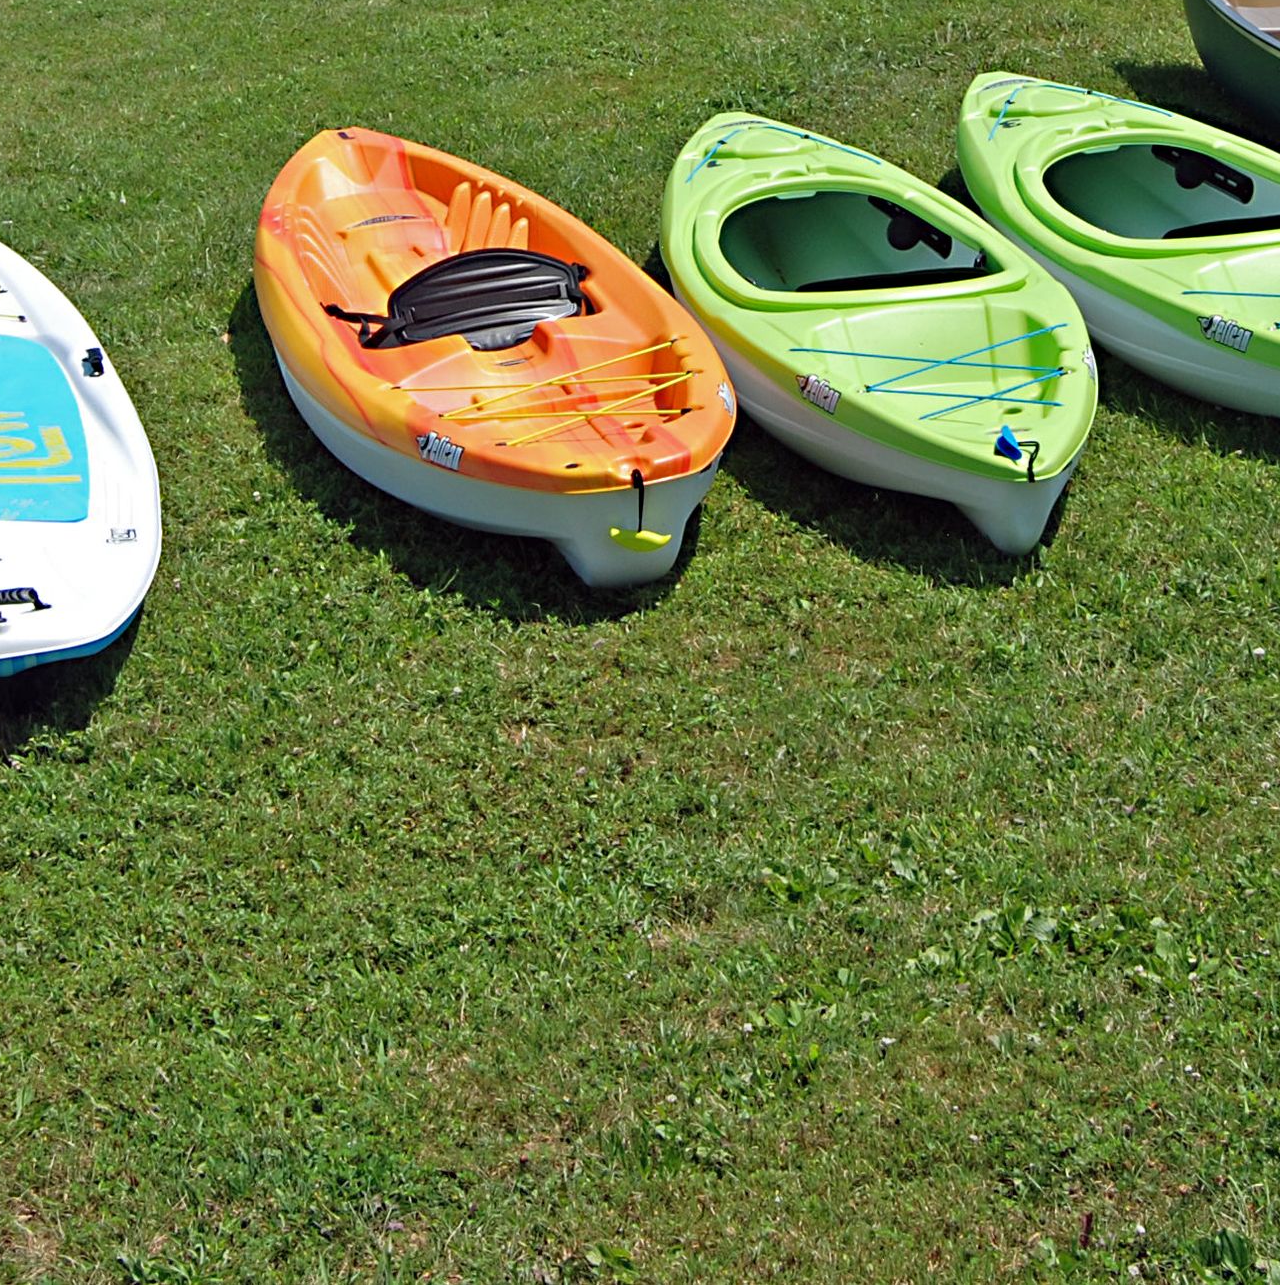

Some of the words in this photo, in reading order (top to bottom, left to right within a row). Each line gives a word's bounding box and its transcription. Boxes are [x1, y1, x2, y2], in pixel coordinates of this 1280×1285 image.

[1203, 315, 1253, 354] Pelican
[801, 375, 842, 415] Pelican
[421, 430, 464, 472] Pelican
